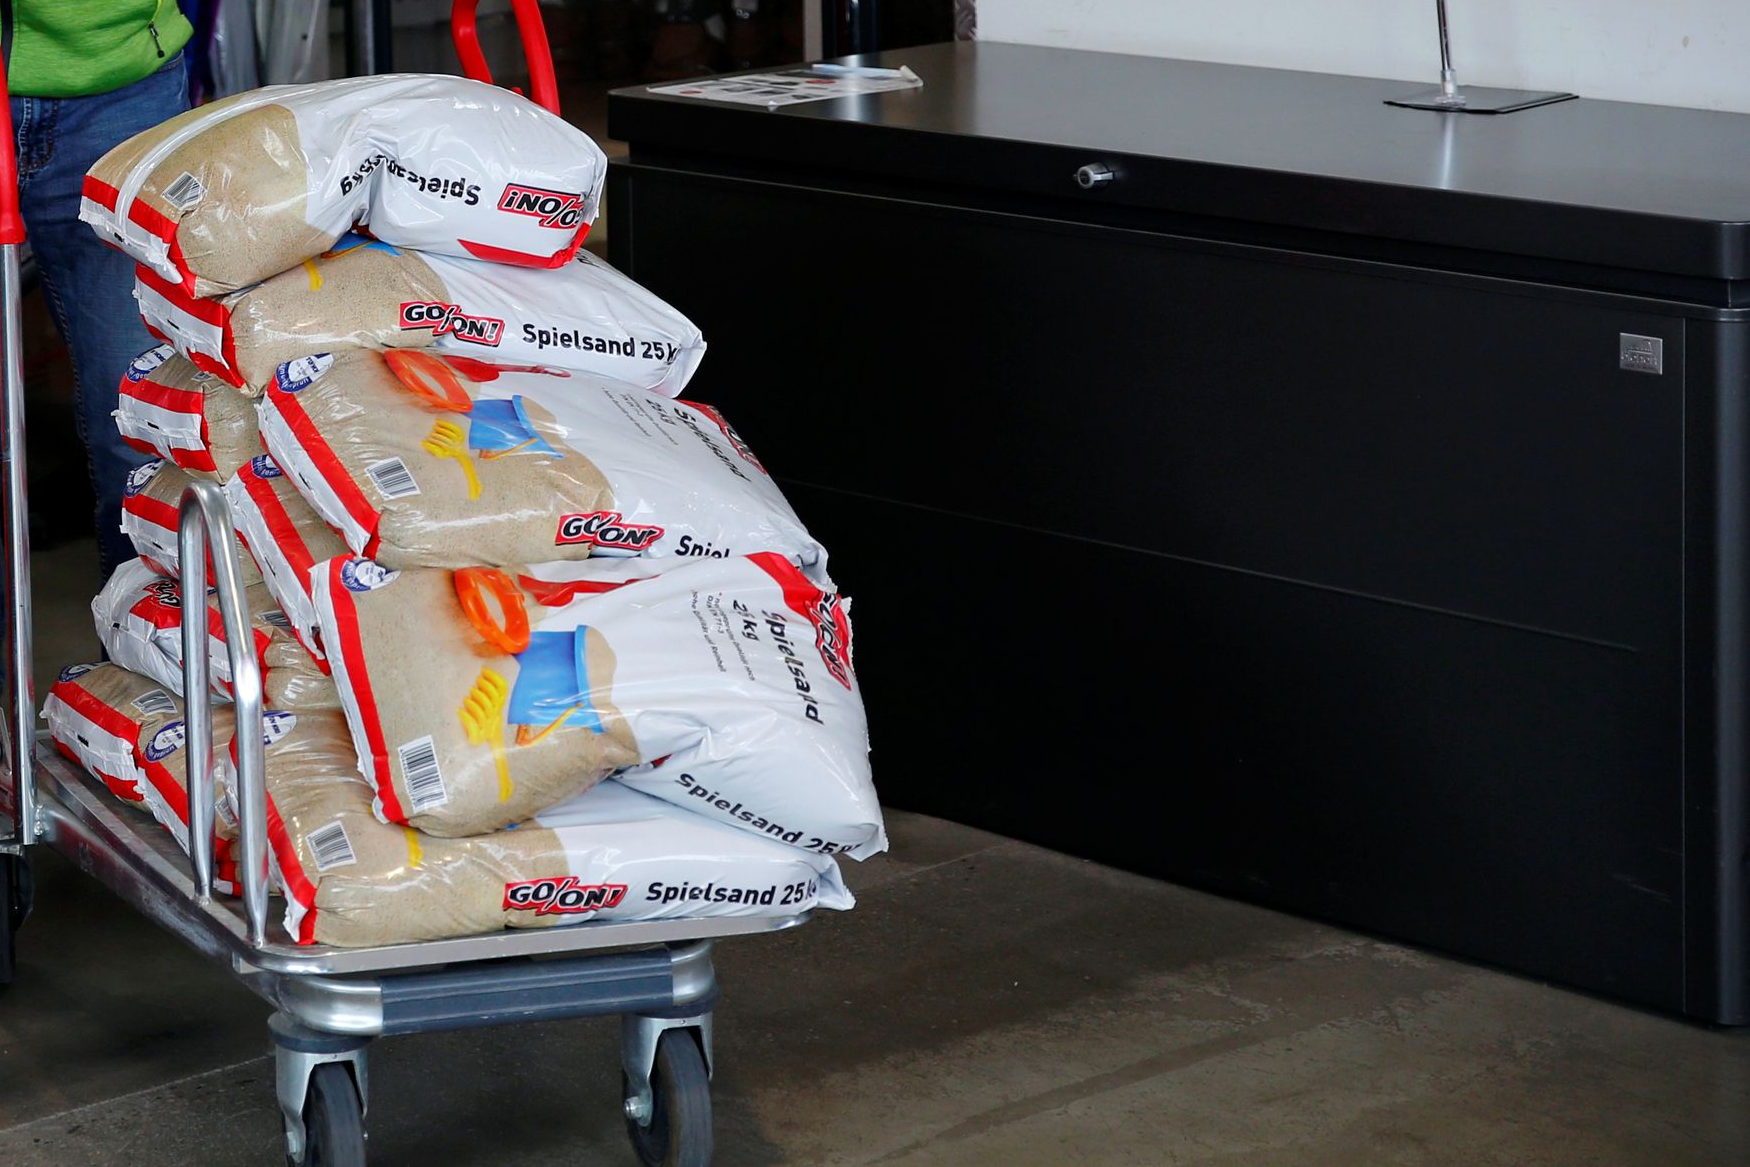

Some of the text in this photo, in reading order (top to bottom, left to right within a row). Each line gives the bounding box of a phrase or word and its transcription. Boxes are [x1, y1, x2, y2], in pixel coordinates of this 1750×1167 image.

[522, 323, 636, 358] Spielsand
[641, 340, 665, 361] 25
[742, 618, 760, 642] kg
[761, 609, 825, 727] Spielsand
[675, 772, 804, 846] Spielsand
[802, 837, 837, 854] 25
[646, 881, 776, 906] Spielsand
[780, 884, 804, 906] 25
